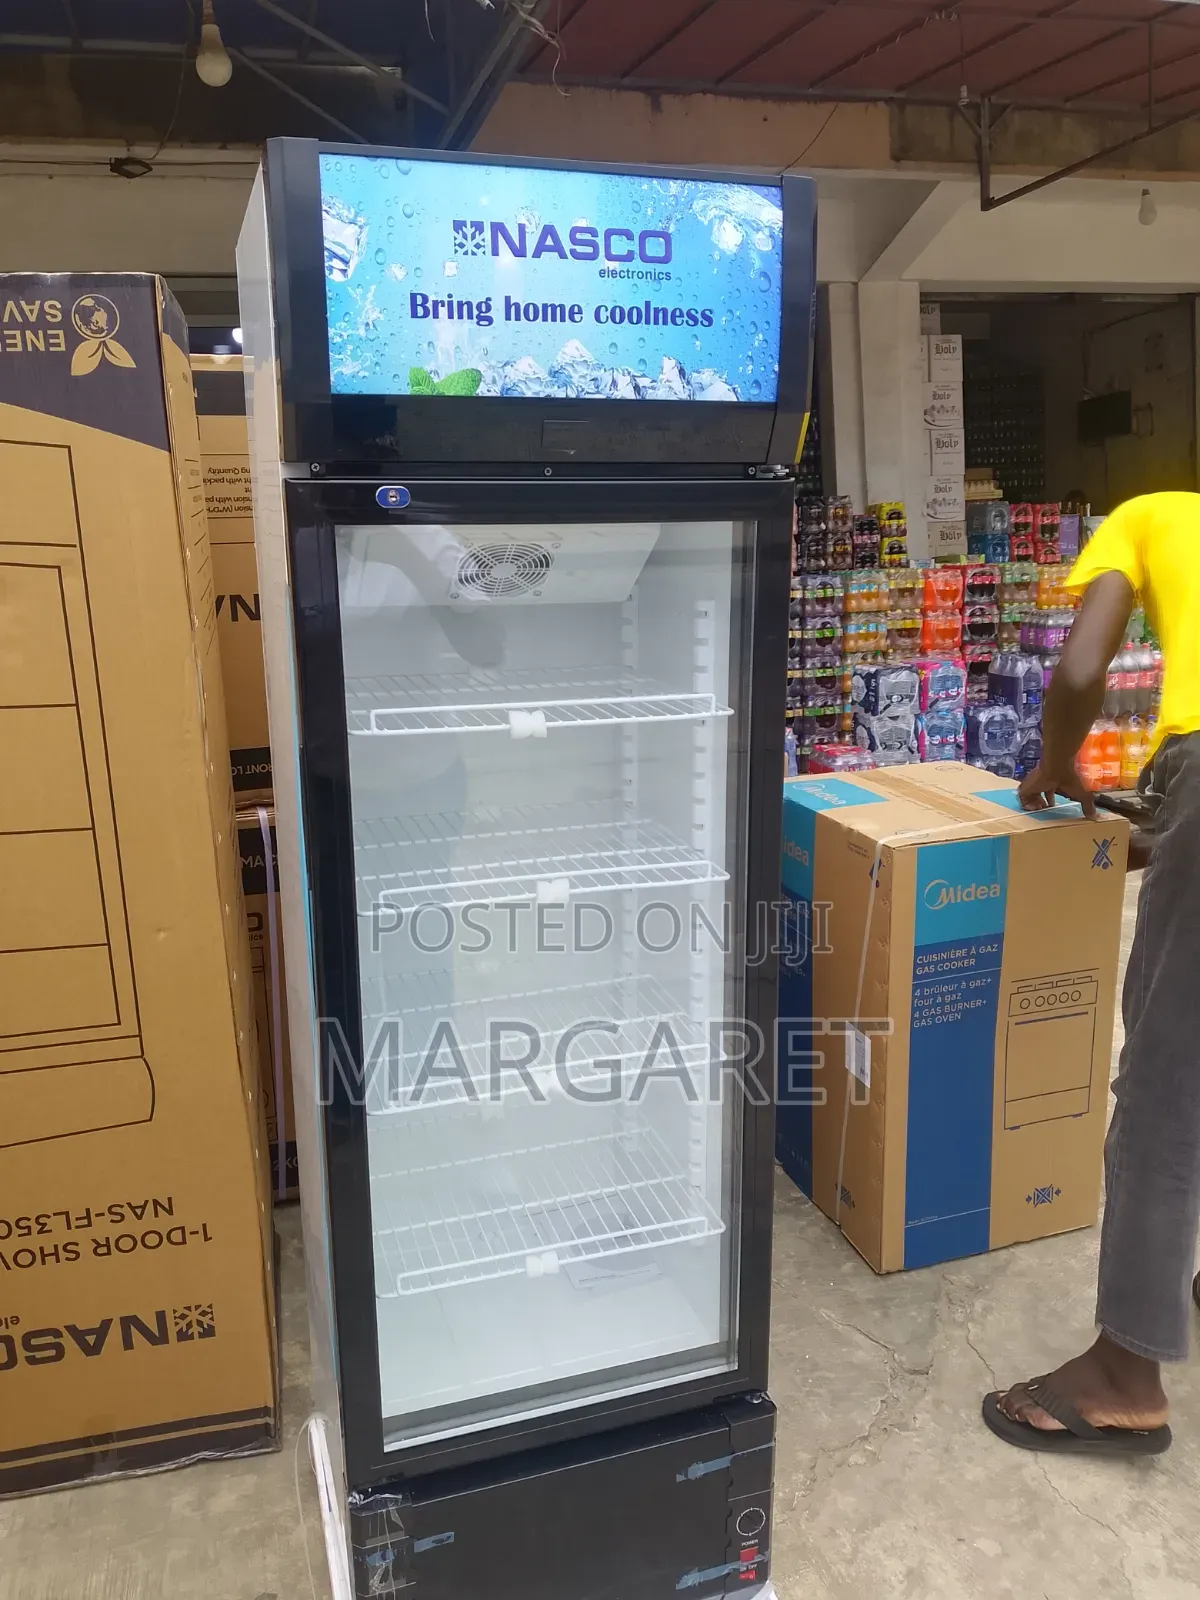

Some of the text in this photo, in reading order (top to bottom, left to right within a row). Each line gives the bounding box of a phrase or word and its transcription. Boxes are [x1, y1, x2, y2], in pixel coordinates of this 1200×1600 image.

[490, 220, 673, 265] NASCO
[598, 266, 672, 282] electronics
[408, 291, 714, 328] Bring home coolness
[0, 330, 66, 352] ENE
[207, 466, 240, 475] Quantity
[798, 784, 847, 805] Midea
[783, 836, 809, 866] idea
[930, 880, 1000, 908] Midea
[916, 948, 968, 964] CUISINIÈRE
[978, 944, 998, 954] GAZ
[916, 958, 976, 975] GAS COOKER
[914, 989, 921, 997] 4
[923, 983, 958, 996] brûleur
[960, 981, 967, 989] à
[914, 993, 962, 1007] four à gaz
[913, 1012, 962, 1028] GAS OVEN
[922, 1006, 942, 1017] GAS
[90, 1222, 213, 1258] 1-DOOR
